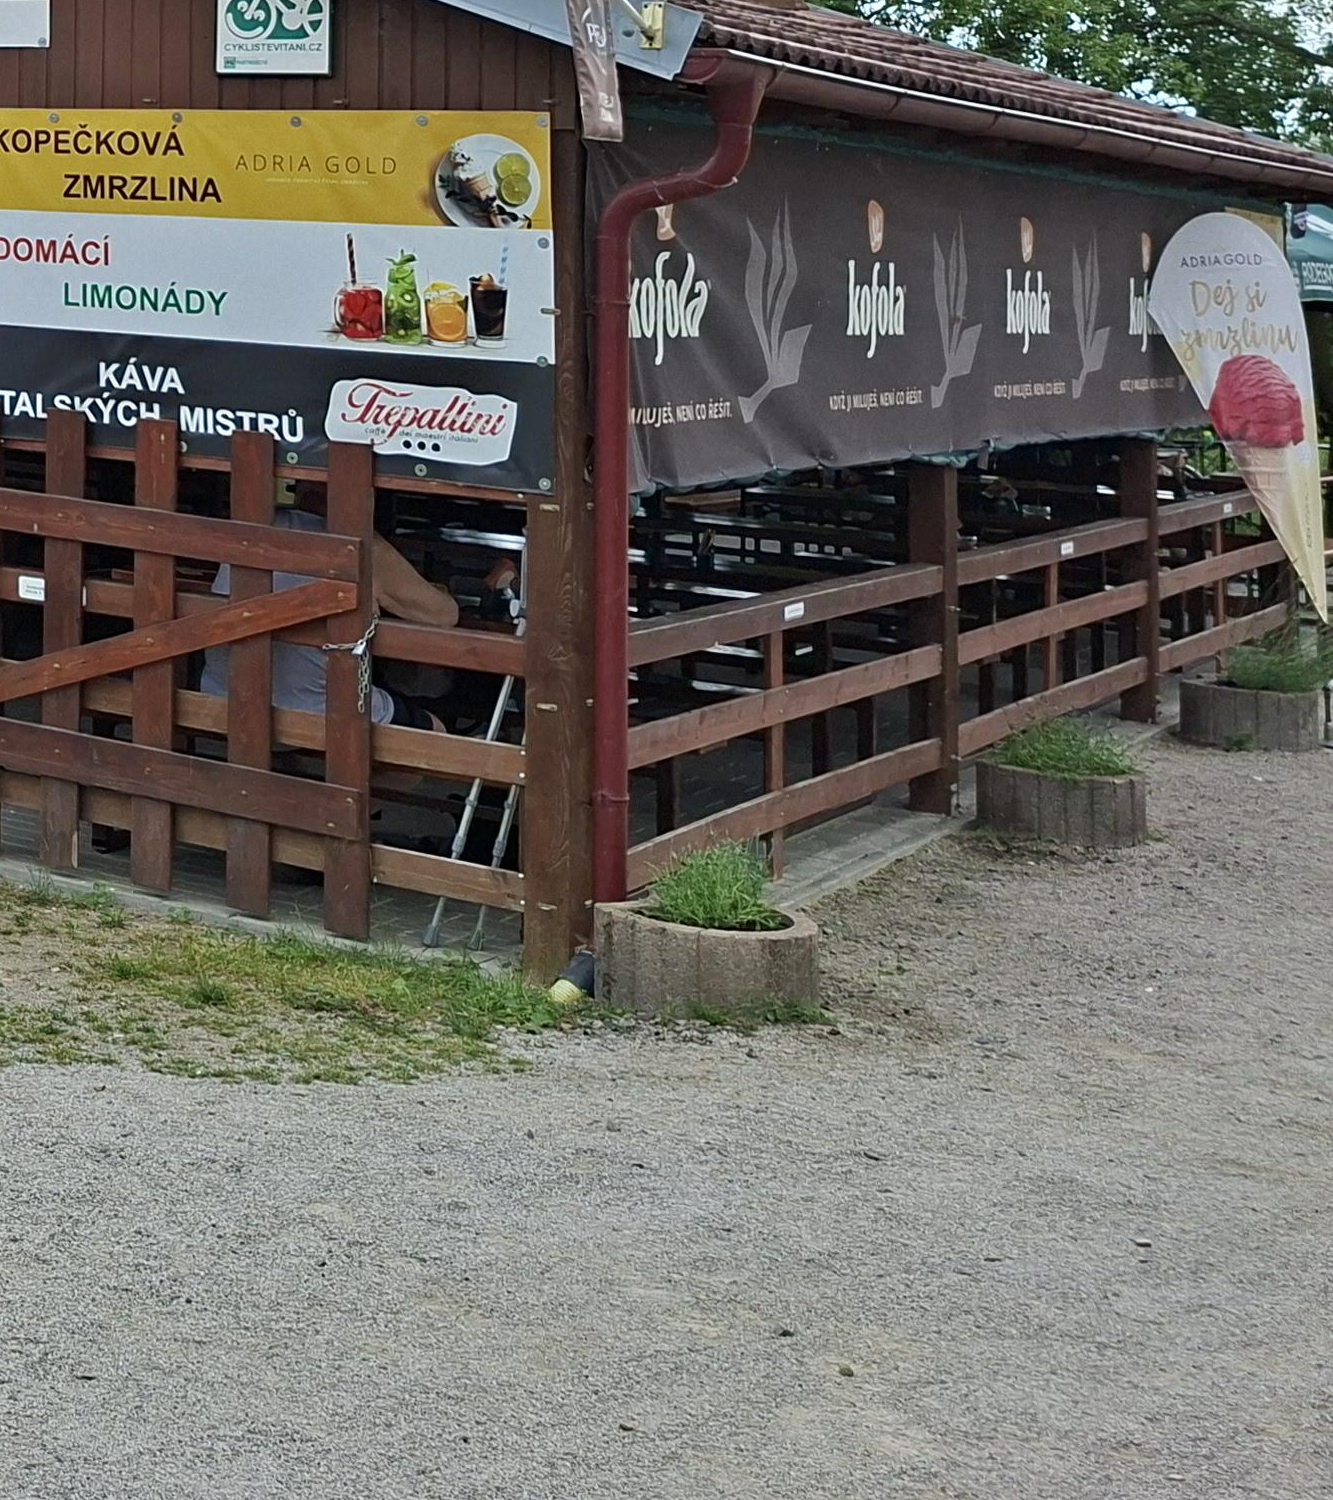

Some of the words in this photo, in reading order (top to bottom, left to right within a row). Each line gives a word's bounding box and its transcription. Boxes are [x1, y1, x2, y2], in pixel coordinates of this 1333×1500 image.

[224, 43, 322, 52] CYKLISTEVITANI.CZ
[235, 154, 312, 172] ADRIA
[325, 156, 396, 174] GOLD
[63, 173, 221, 202] ZMRZLINA
[63, 278, 228, 317] LIMONÁDY
[846, 260, 904, 358] kofola
[1006, 268, 1050, 354] kofola
[1189, 280, 1238, 317] Dej
[1245, 281, 1266, 313] si
[1181, 318, 1298, 361] zmrzlinu
[99, 357, 184, 394] KÁVA
[180, 405, 303, 443] MISTRŮ
[676, 400, 694, 422] NENÍ
[695, 403, 707, 420] CO
[415, 431, 447, 440] maestri
[449, 433, 478, 443] italiani
